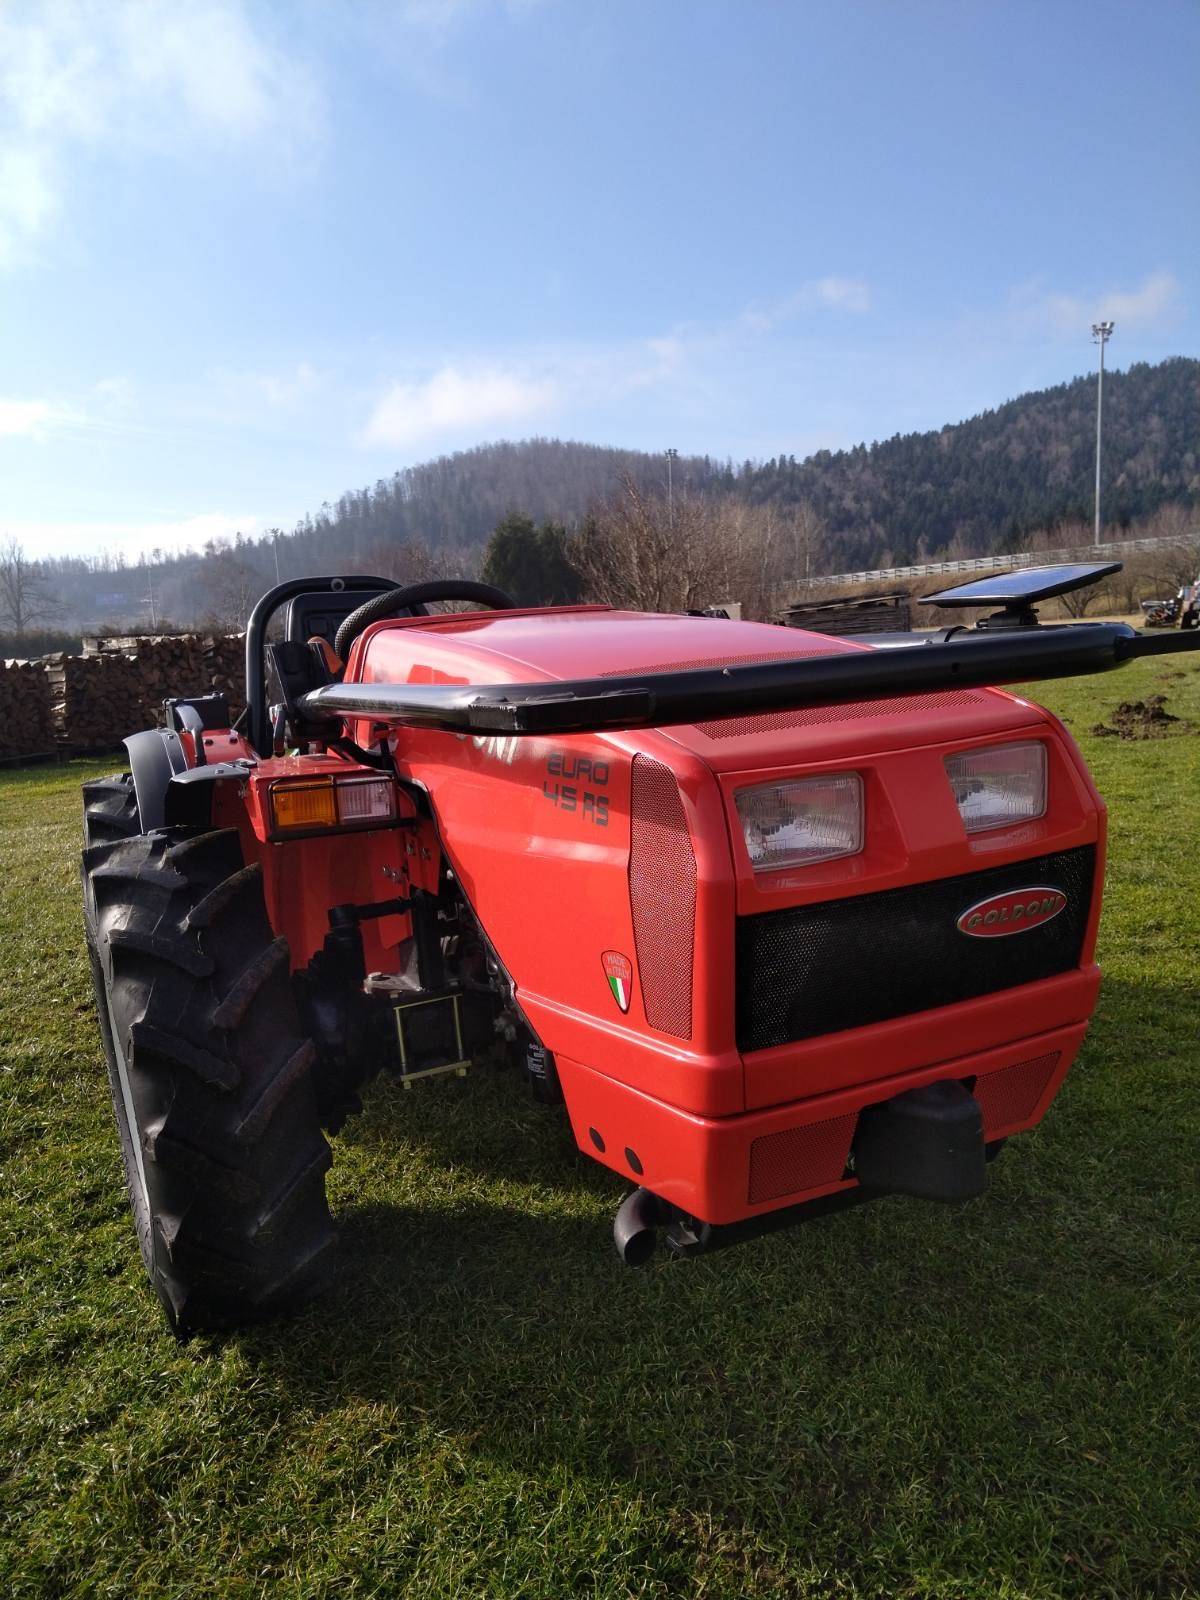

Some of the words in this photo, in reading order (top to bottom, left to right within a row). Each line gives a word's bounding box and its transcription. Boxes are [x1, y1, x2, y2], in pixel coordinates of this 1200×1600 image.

[546, 753, 609, 785] EURO
[543, 781, 577, 811] 45
[582, 791, 609, 827] RS
[967, 895, 1062, 929] GOLDONI
